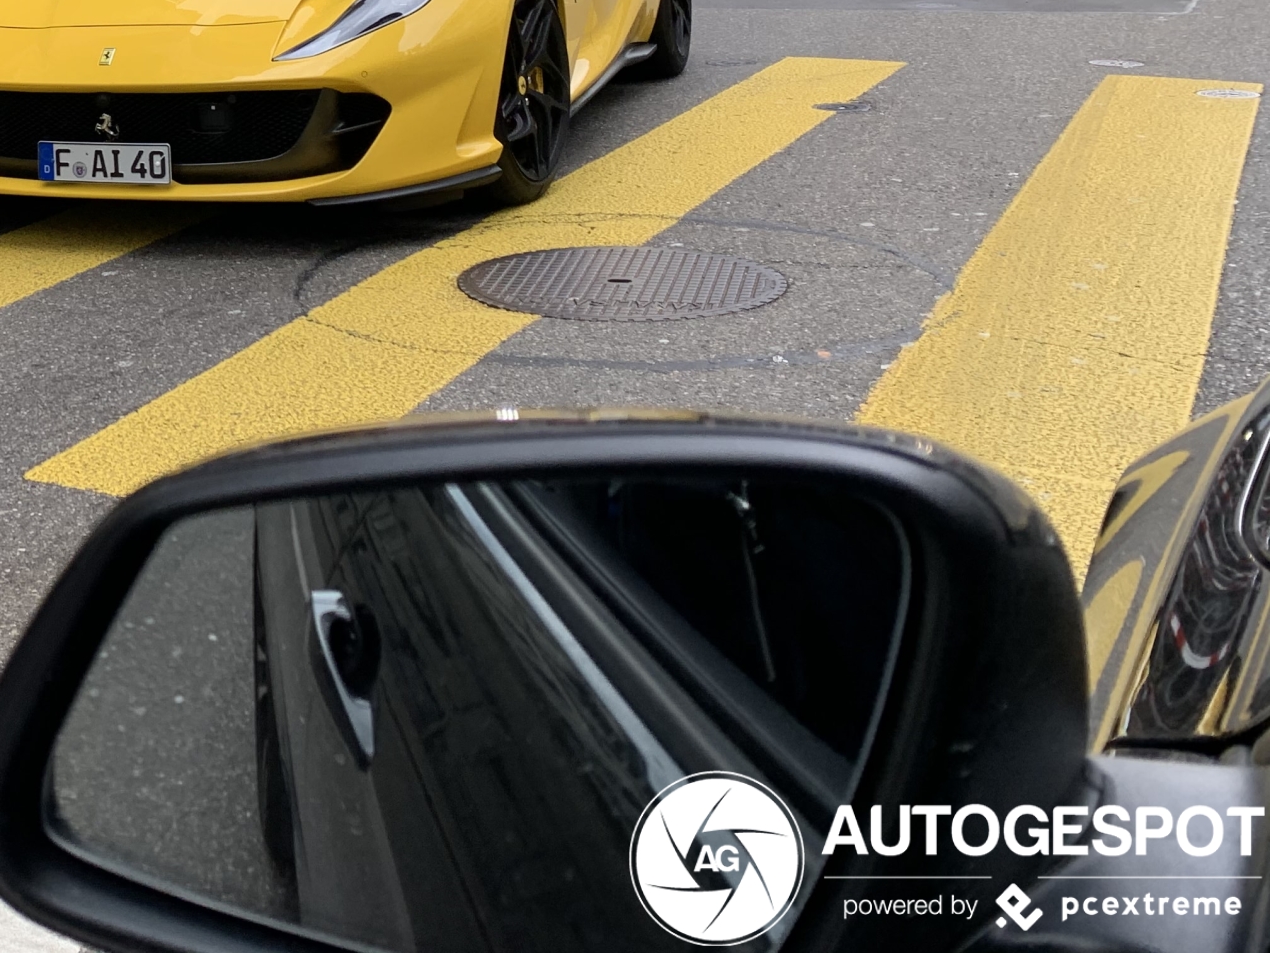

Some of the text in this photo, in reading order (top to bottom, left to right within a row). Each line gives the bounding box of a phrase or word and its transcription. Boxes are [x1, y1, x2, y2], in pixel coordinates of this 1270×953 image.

[44, 149, 166, 179] D F AI 40
